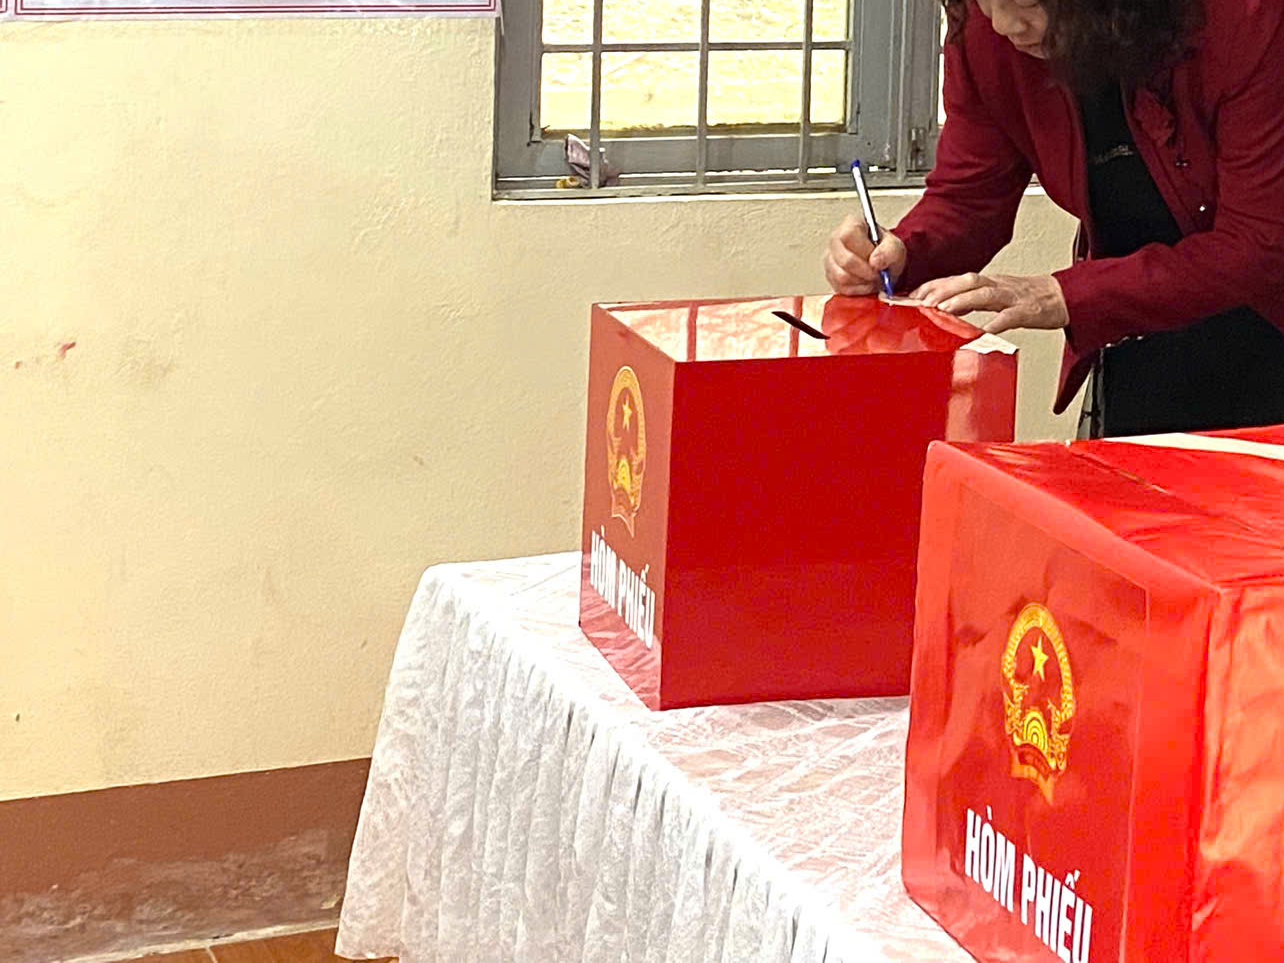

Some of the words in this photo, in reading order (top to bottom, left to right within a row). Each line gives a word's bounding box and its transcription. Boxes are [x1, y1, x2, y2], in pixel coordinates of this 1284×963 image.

[590, 524, 618, 610] HÒM
[617, 563, 656, 650] PHIẾU
[965, 804, 1017, 914] HÒM
[1020, 852, 1094, 963] PHIẾU
